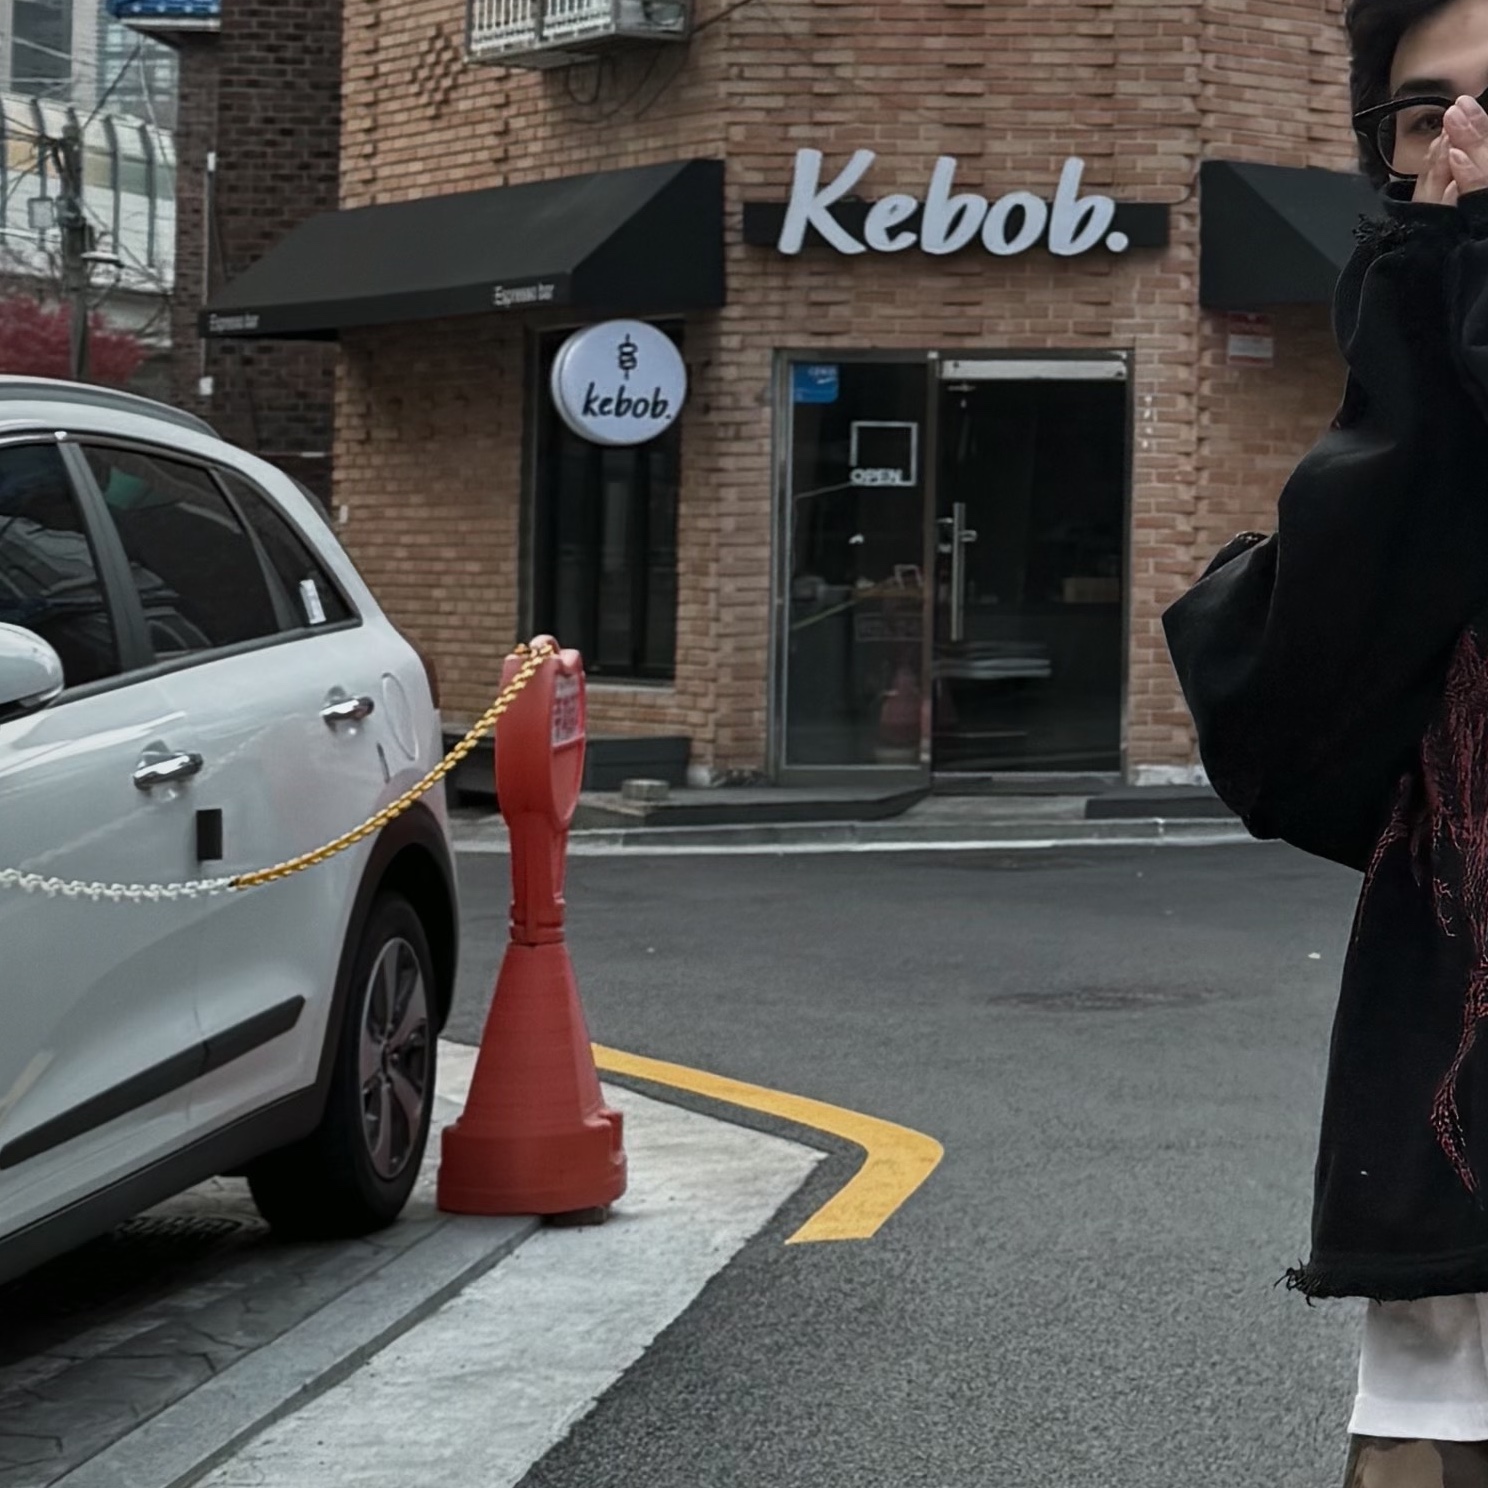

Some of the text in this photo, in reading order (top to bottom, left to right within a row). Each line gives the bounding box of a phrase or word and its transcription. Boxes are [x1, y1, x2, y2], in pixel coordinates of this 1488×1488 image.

[778, 148, 1129, 256] Kebob.
[581, 381, 672, 419] kebob.
[849, 468, 903, 486] OPEN
